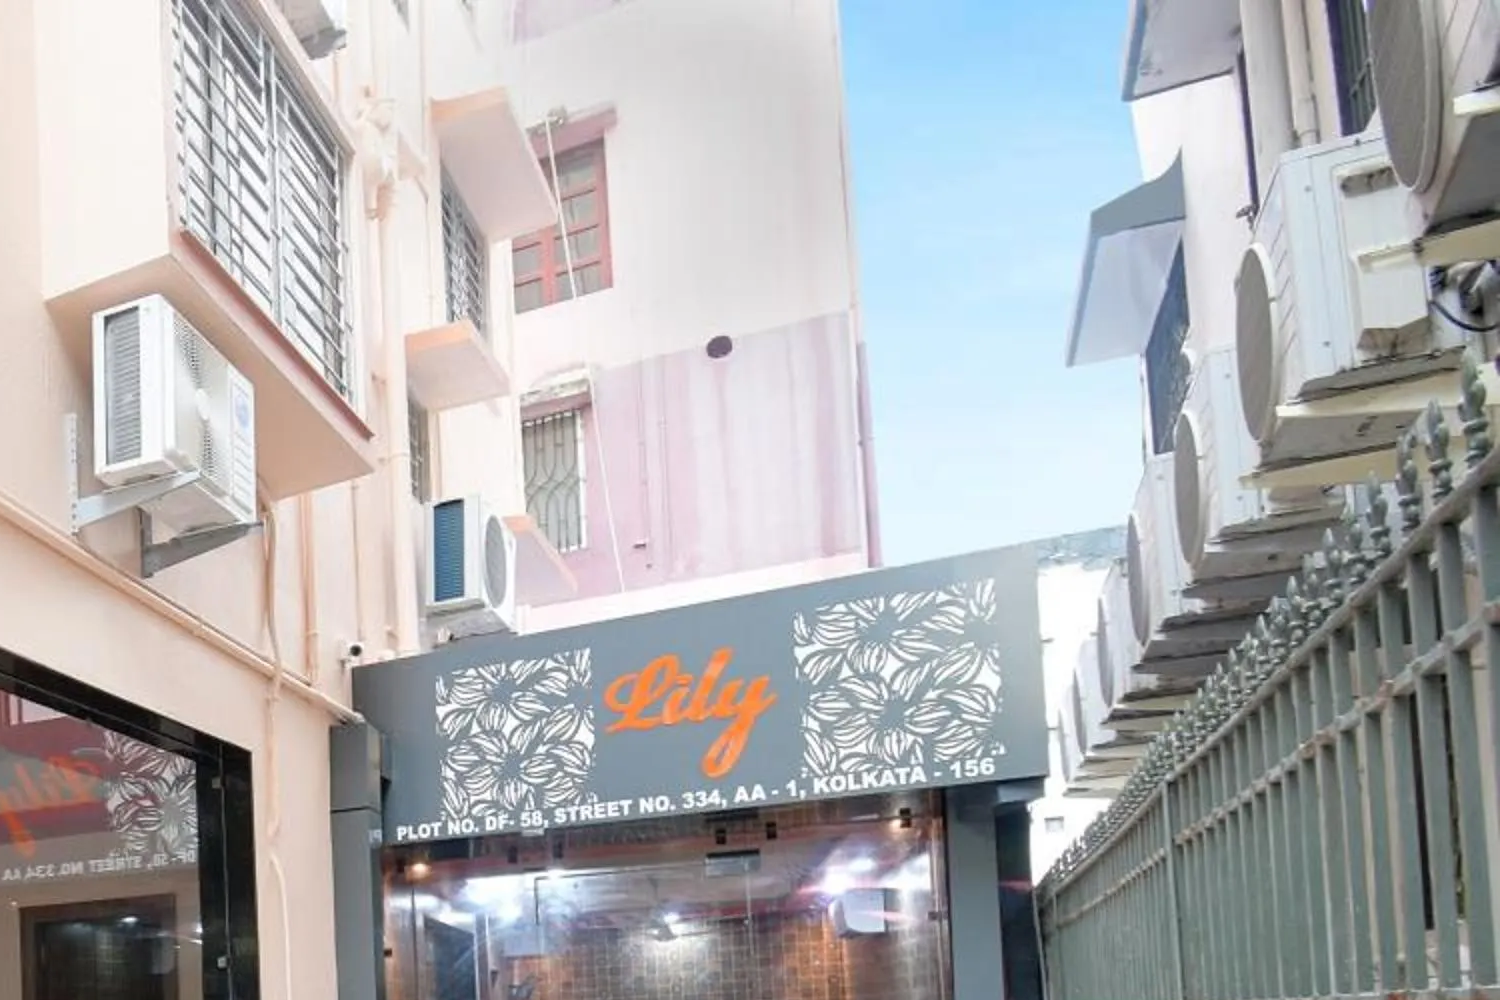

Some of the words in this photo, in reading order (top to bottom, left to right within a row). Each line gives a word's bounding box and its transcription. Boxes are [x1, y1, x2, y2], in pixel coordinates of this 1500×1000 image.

[604, 646, 778, 778] Lily
[396, 823, 442, 841] PLOT
[448, 819, 479, 835] NO.
[520, 809, 549, 828] 58,
[554, 800, 632, 824] STREET
[639, 795, 676, 814] NO.
[682, 788, 727, 809] 334,
[733, 784, 766, 803] AA
[786, 779, 806, 798] 1,
[813, 765, 927, 795] KOLKATA
[950, 758, 995, 778] 156
